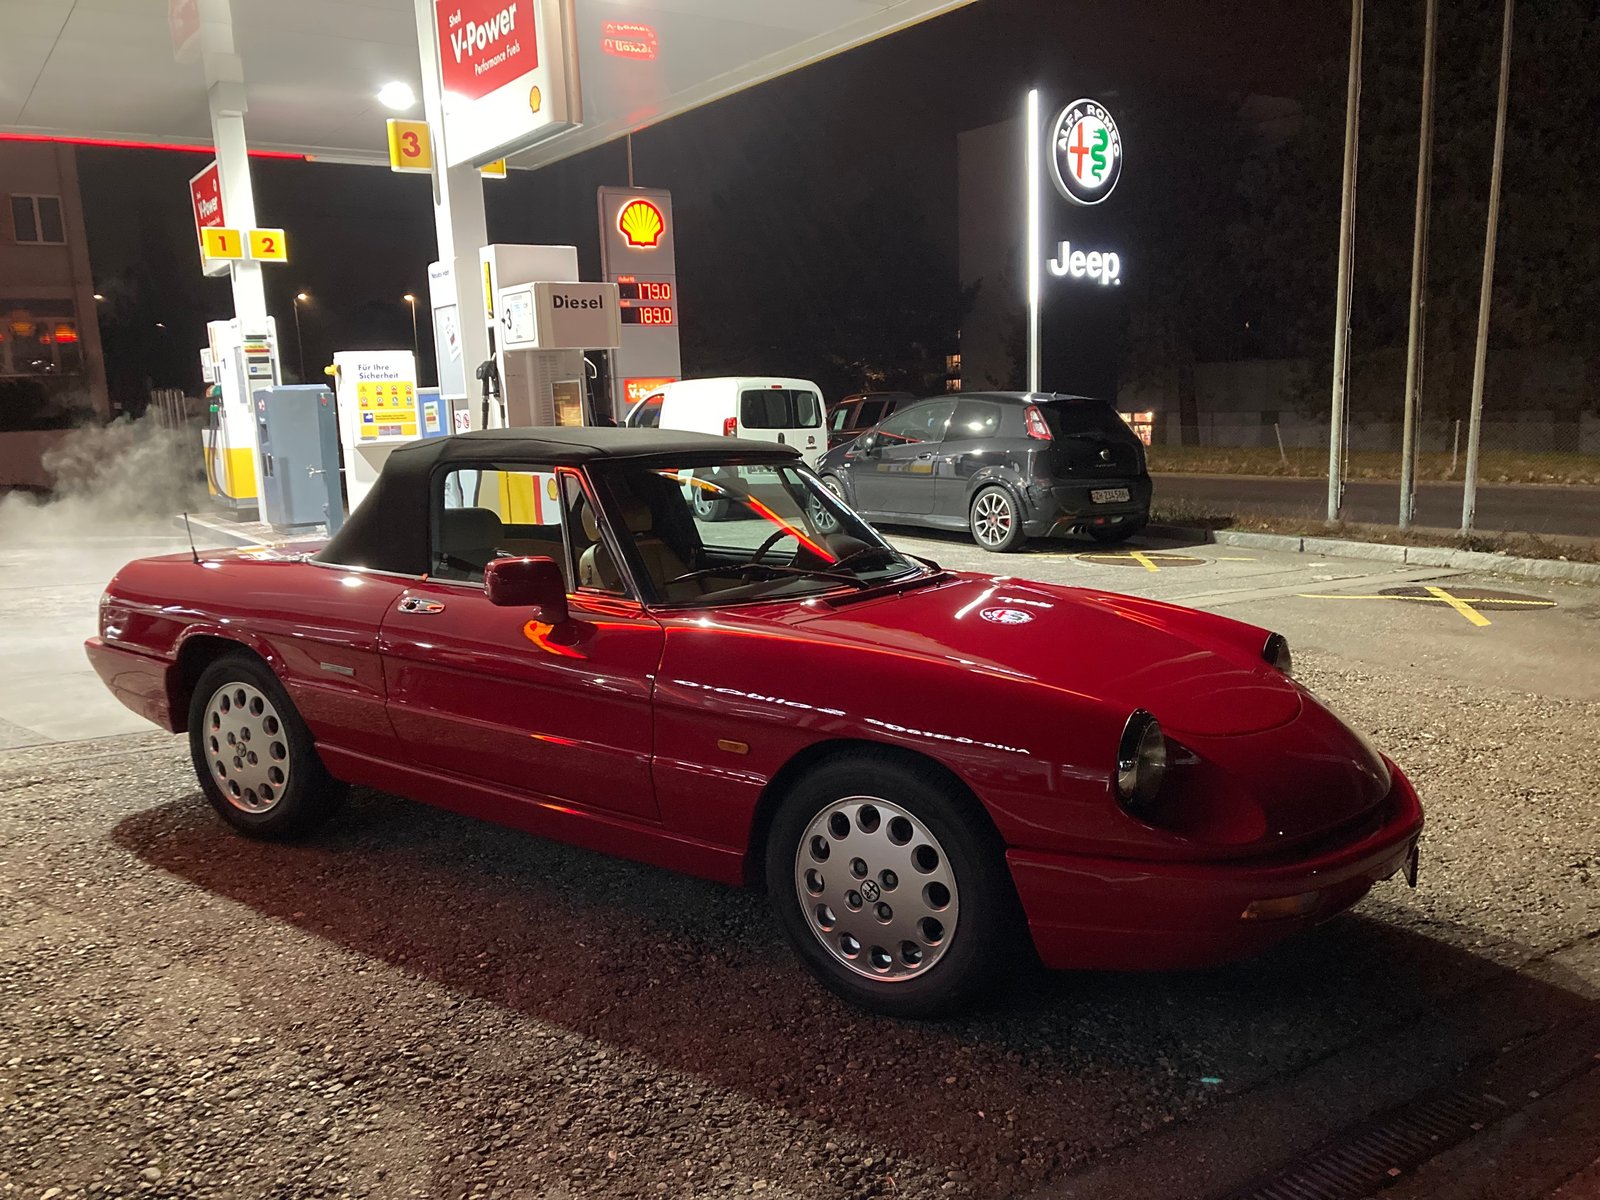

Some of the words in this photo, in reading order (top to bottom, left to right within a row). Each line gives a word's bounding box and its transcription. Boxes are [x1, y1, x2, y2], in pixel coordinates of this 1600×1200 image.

[449, 9, 462, 28] Shell
[450, 3, 517, 64] V-Power
[474, 50, 506, 76] Performance
[506, 39, 521, 59] Fuels
[1057, 107, 1083, 150] ALFA
[1086, 104, 1121, 157] ROMEO
[402, 131, 421, 158] 3
[218, 235, 227, 252] 1
[261, 237, 275, 253] 2
[1047, 240, 1120, 285] Jeep
[638, 283, 671, 300] 179.0
[552, 294, 603, 309] Diesel
[506, 308, 513, 331] 3
[639, 307, 673, 324] 189.0
[358, 363, 371, 371] Für
[373, 363, 390, 371] Ihre
[359, 371, 399, 380] Sicherheit
